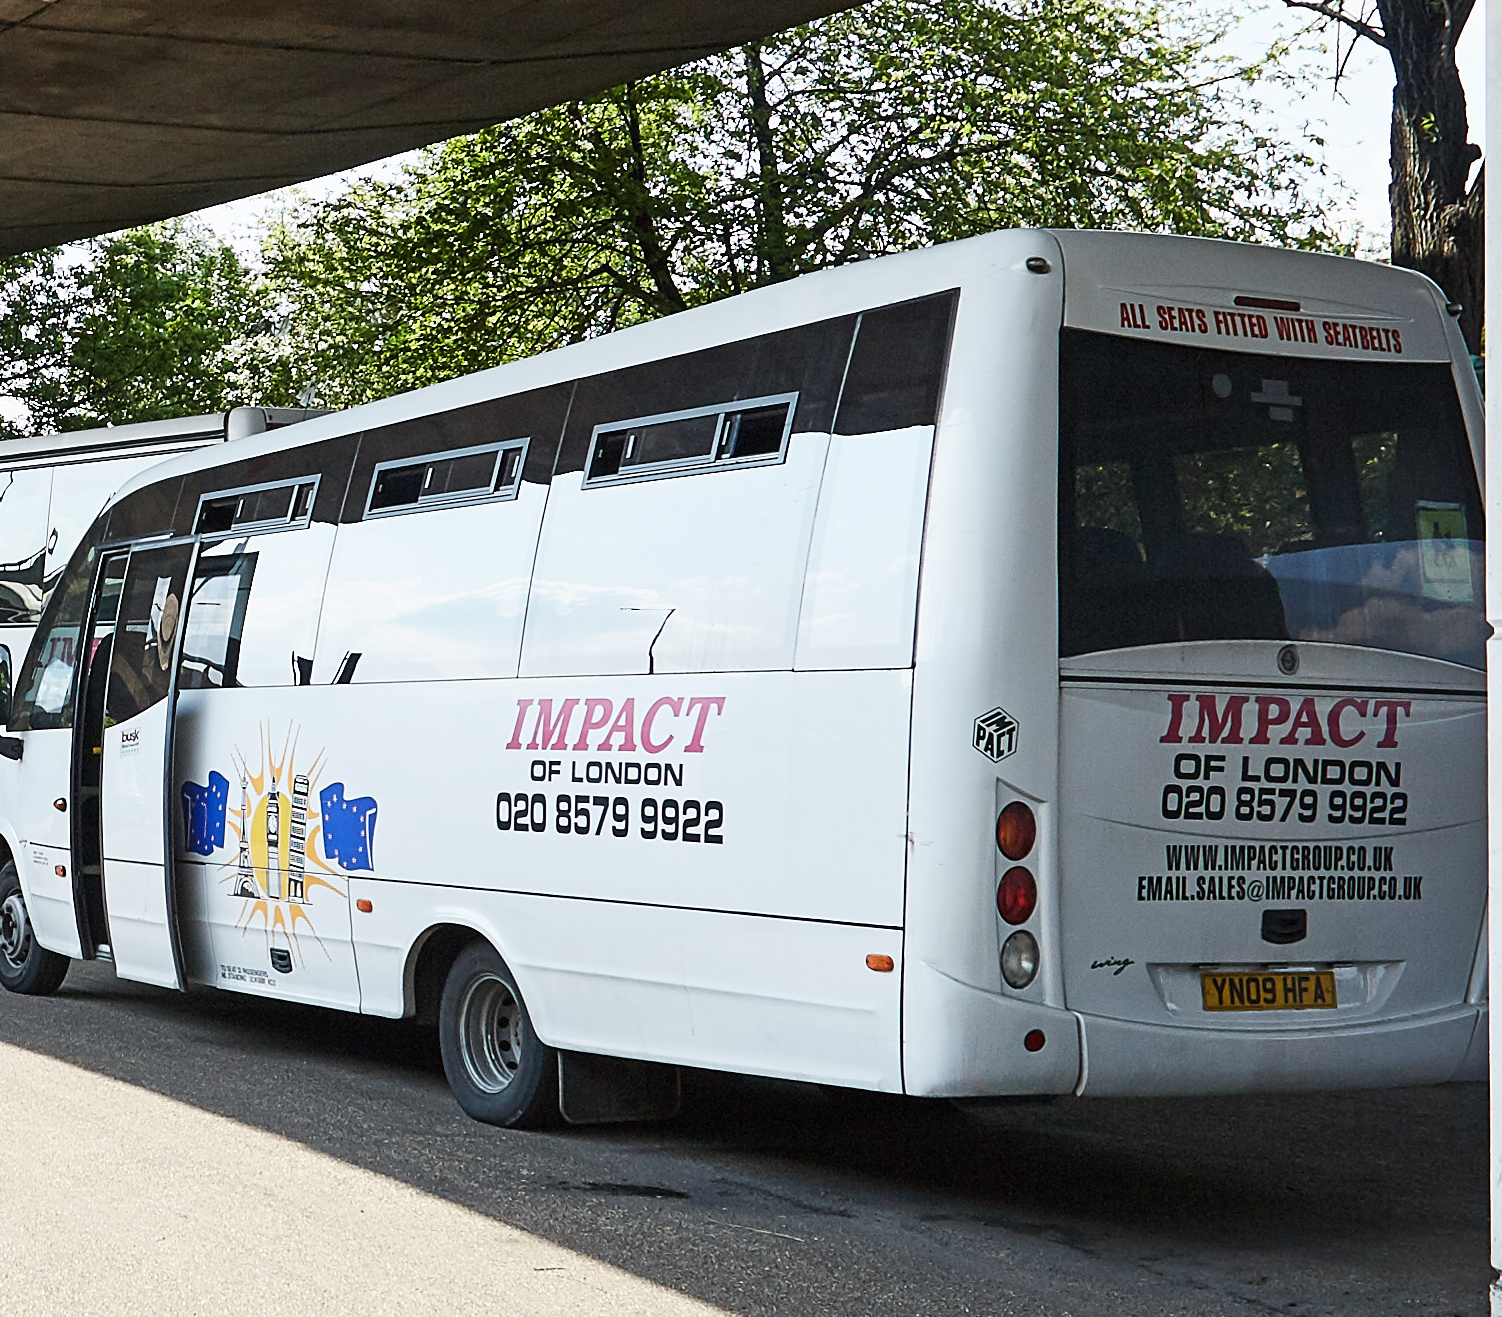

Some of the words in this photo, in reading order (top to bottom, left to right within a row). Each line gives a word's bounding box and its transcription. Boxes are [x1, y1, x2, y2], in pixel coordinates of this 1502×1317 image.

[1120, 302, 1150, 329] ALL
[1156, 305, 1208, 334] SEATS
[1213, 310, 1269, 339] FITTED
[1274, 316, 1318, 344] WITH
[1322, 320, 1403, 354] SEATBELTS
[505, 696, 726, 754] IMPACT
[1159, 693, 1412, 749] IMPACT
[530, 759, 562, 782] OF
[571, 760, 684, 787] LONDON
[1173, 753, 1226, 781] OF
[1241, 756, 1402, 788] LONDON
[496, 791, 547, 833] 020
[555, 793, 629, 838] 8579
[640, 797, 724, 845] 9922
[1161, 784, 1226, 821] 020
[1234, 786, 1318, 824] 8579
[1327, 790, 1408, 826] 9922
[1166, 844, 1394, 872] WWW.IMPACTGROUP.CO.UK
[1137, 875, 1423, 902] EMAIL.SALES@IMPACTGROUP.CO.UK
[1212, 977, 1277, 1006] YN09
[1283, 976, 1326, 1004] HFA
